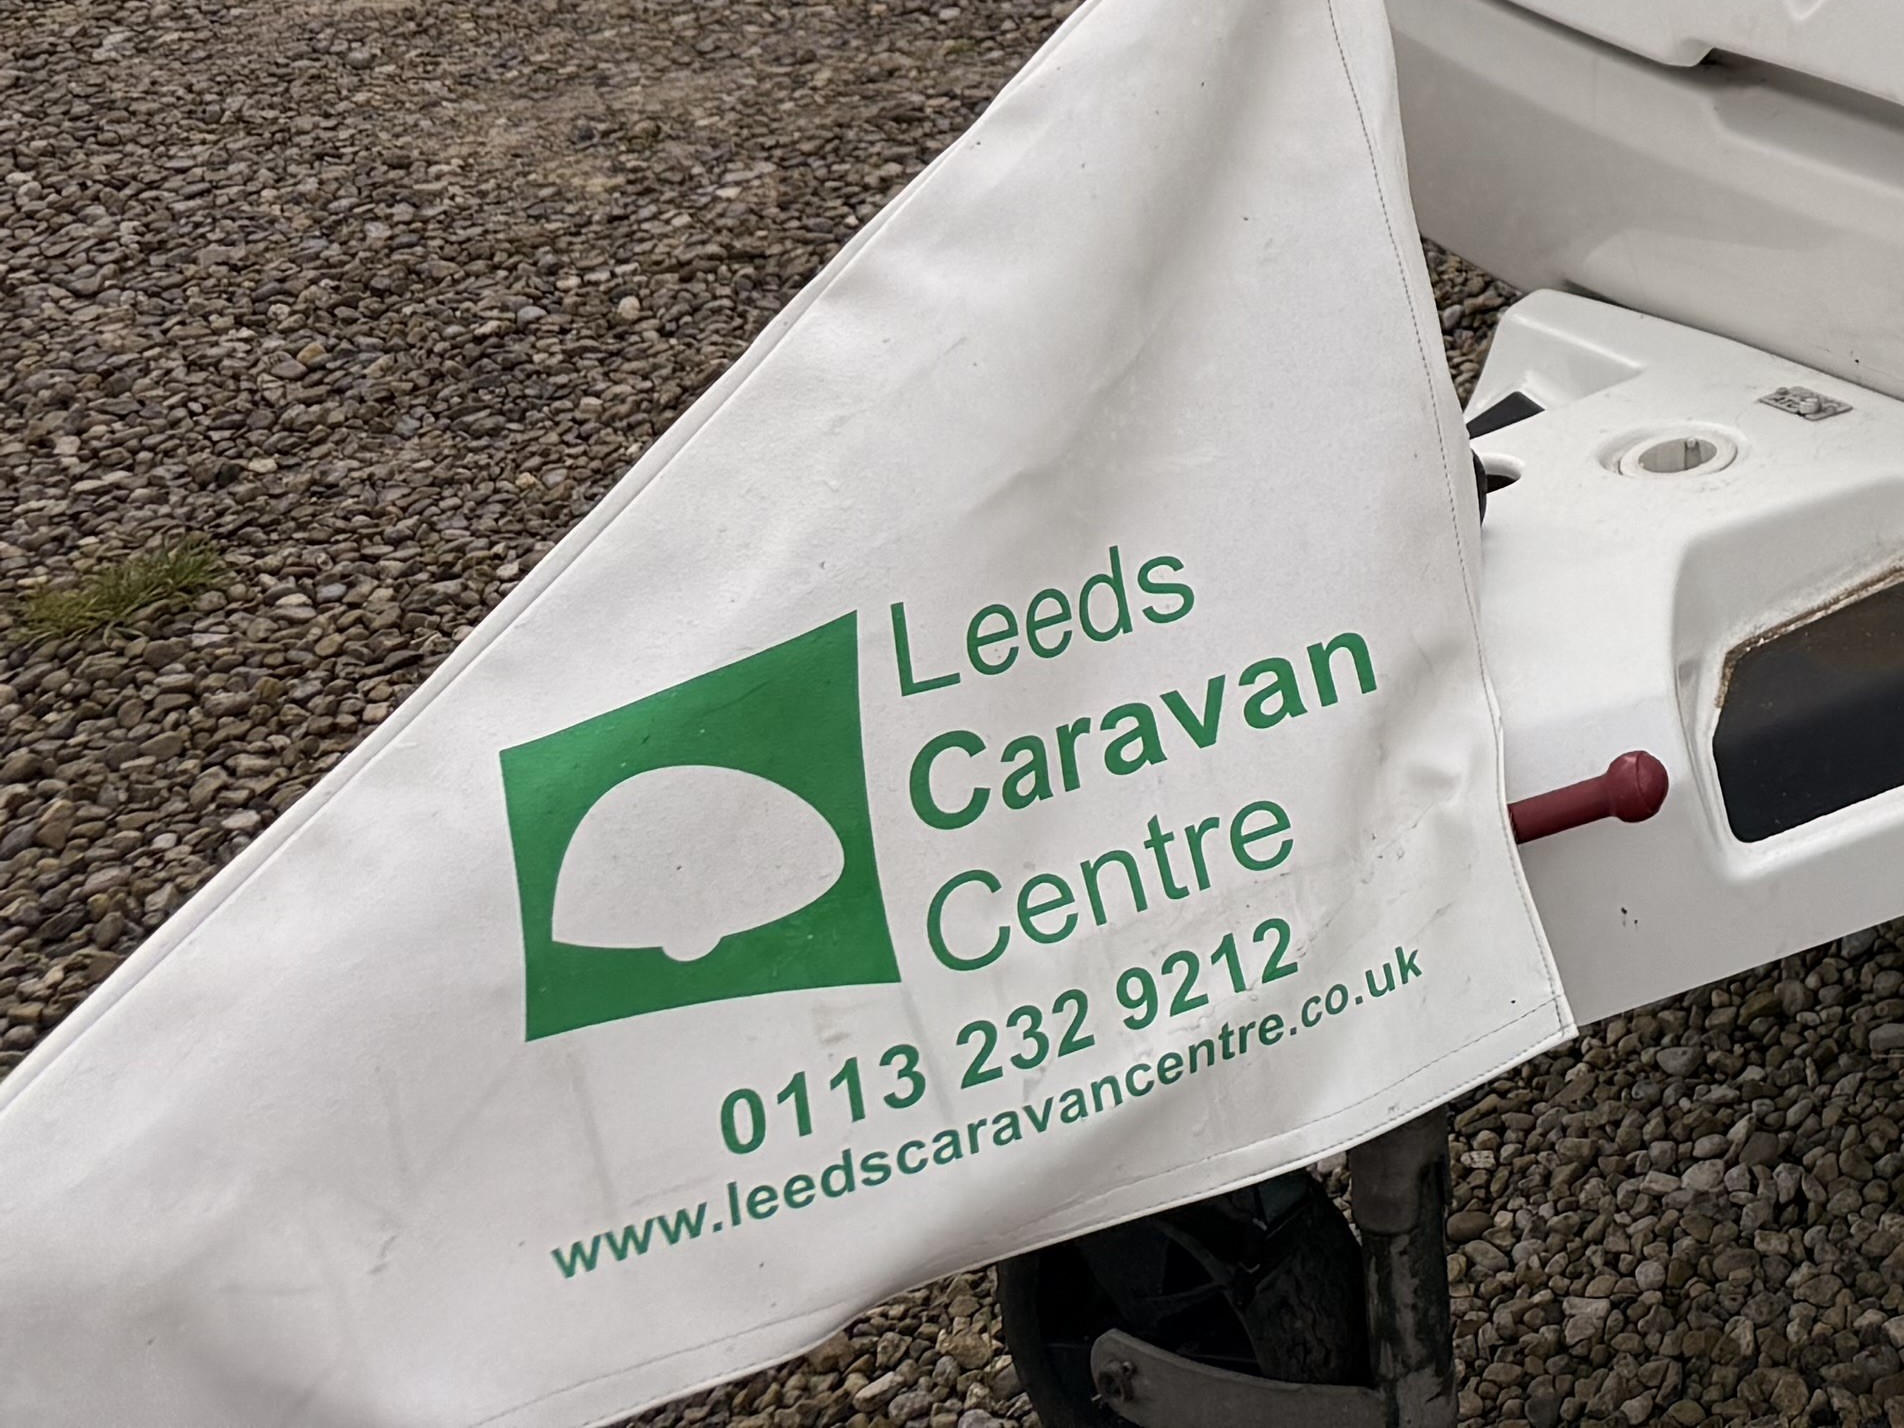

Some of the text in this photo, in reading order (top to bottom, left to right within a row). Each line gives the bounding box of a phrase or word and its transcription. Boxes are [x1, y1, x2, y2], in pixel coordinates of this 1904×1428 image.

[891, 548, 1196, 698] Leeds
[909, 632, 1377, 832] Caravan
[926, 800, 1294, 973] Centre
[551, 942, 1424, 1281] www.leedscaravancentre.co.uk
[720, 917, 1300, 1156] 0113 232 9212
